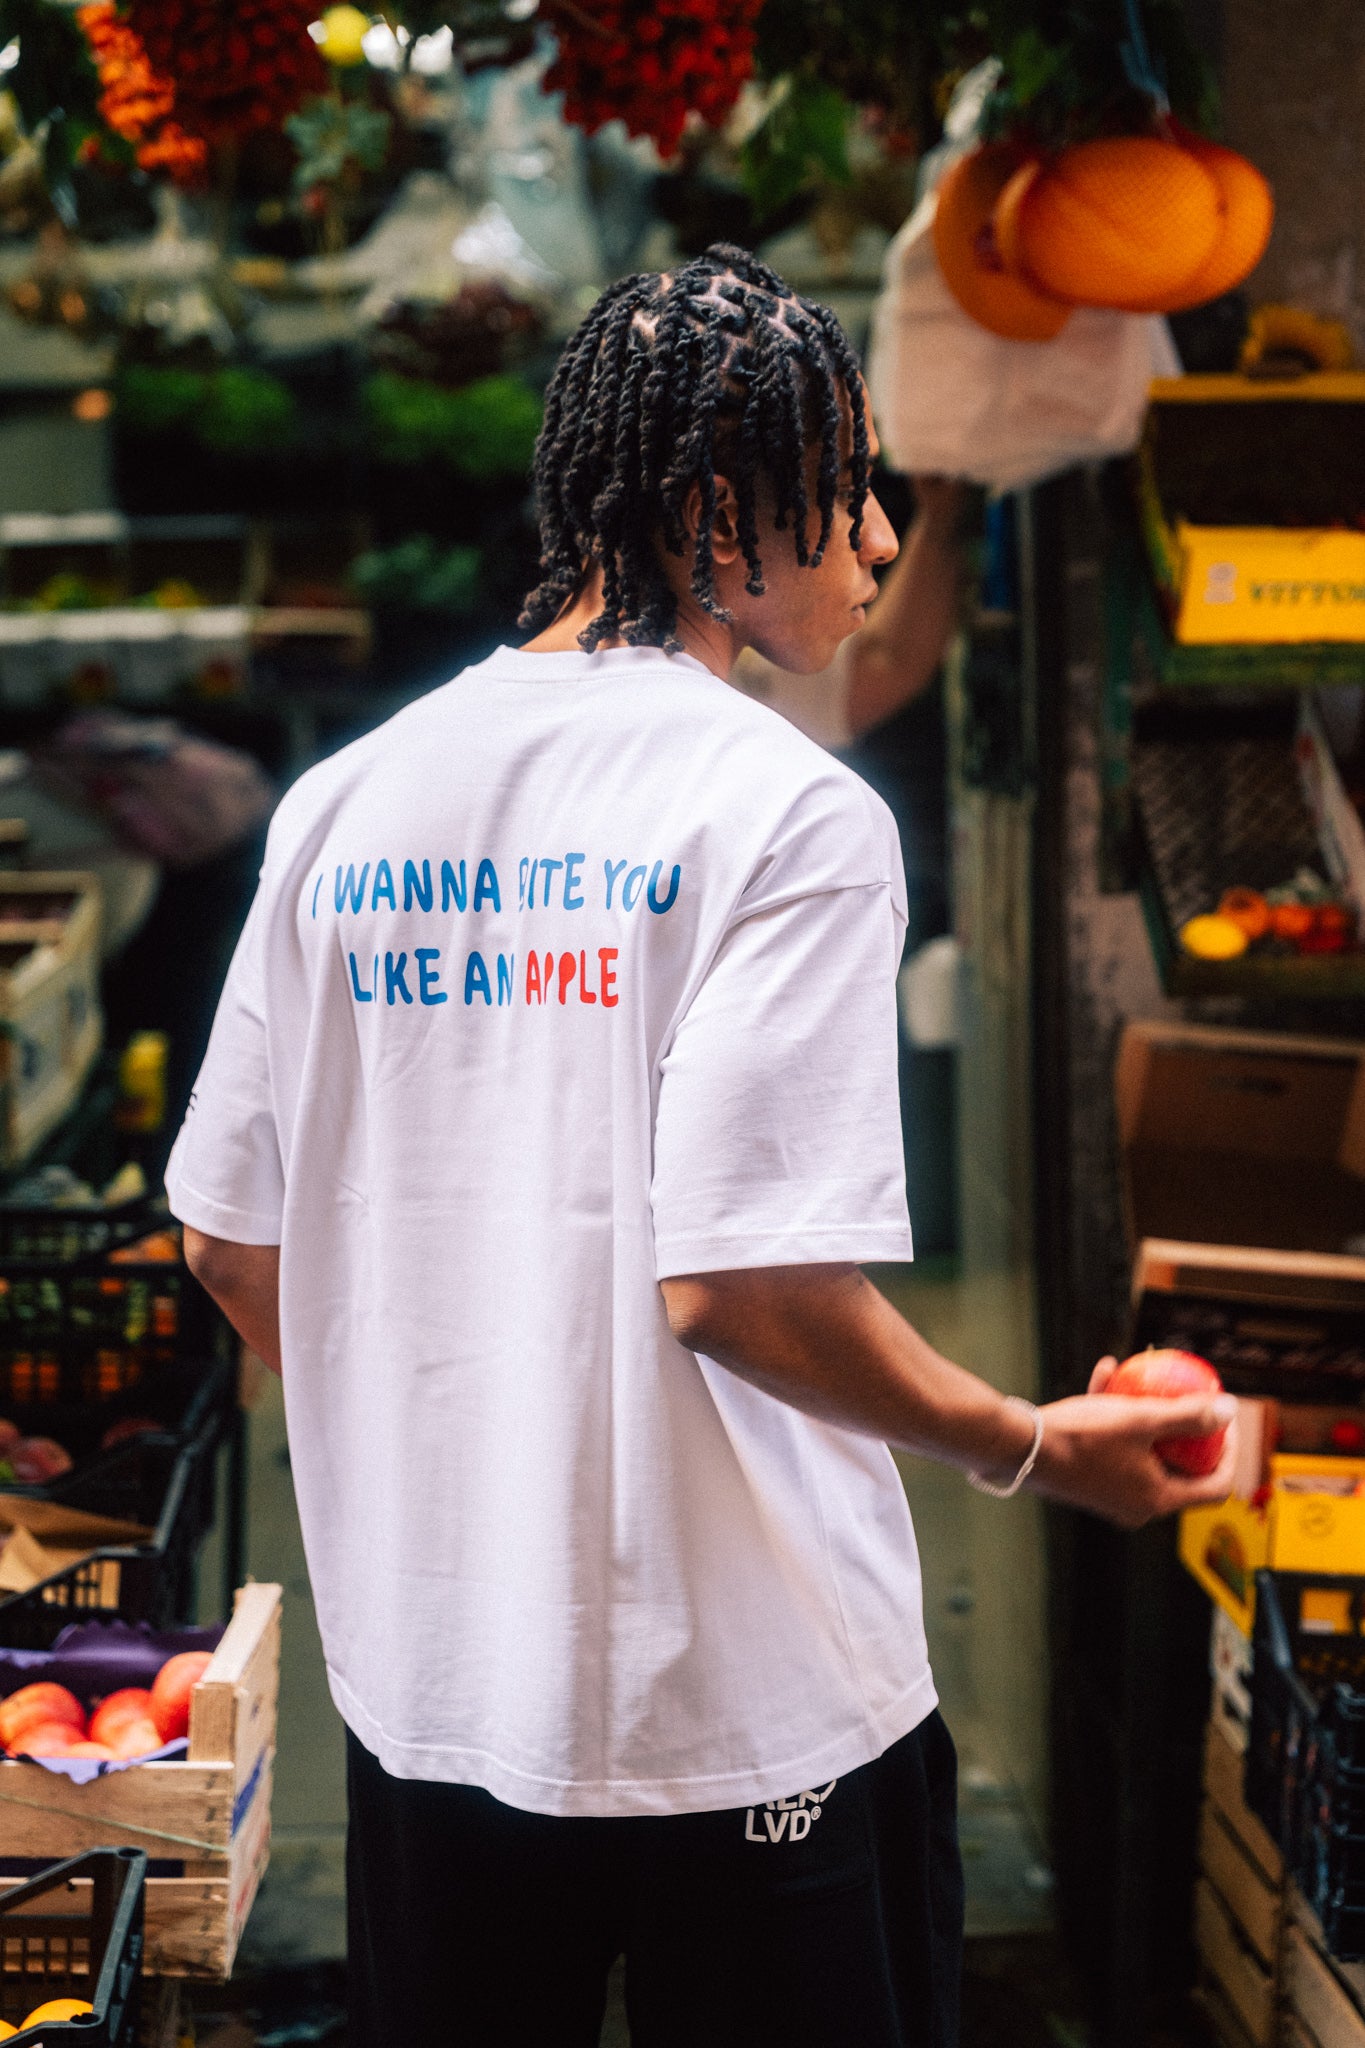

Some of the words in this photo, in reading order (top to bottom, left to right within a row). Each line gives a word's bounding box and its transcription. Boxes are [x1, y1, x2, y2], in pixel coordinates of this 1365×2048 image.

[311, 873, 324, 920] I
[334, 858, 502, 915] WANNA
[603, 858, 682, 915] YOU
[348, 947, 449, 1007] LIKE
[463, 950, 516, 1007] AN
[524, 947, 620, 1008] APPLE
